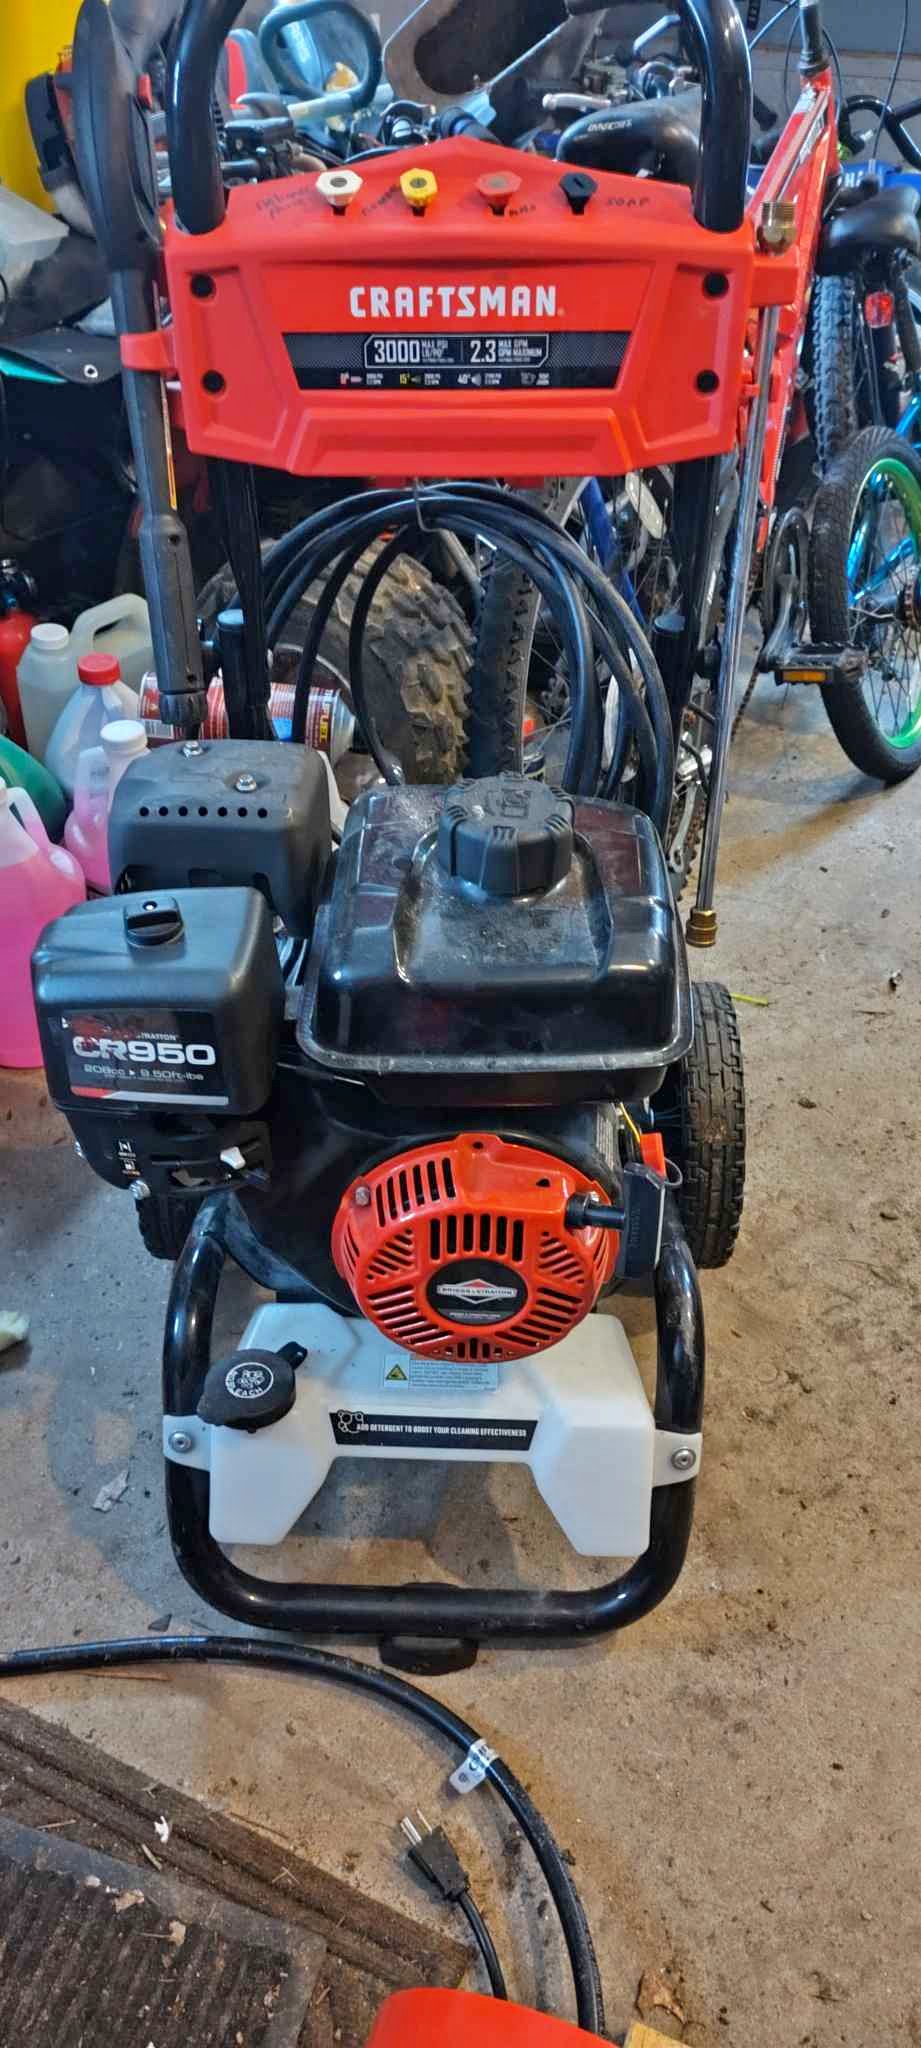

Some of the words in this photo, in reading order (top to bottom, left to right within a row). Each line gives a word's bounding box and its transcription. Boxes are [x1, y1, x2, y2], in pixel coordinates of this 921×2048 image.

[349, 285, 557, 318] CRAFTSMAN
[373, 339, 420, 363] 3000
[470, 339, 497, 363] 2.3
[72, 1036, 216, 1066] CR950
[370, 1424, 404, 1433] DETERGENT
[404, 1425, 413, 1434] TO
[413, 1425, 433, 1435] BOOST
[433, 1426, 450, 1435] YOUR
[450, 1426, 480, 1436] CLEANING
[480, 1427, 527, 1437] EFFECTIVENESS
